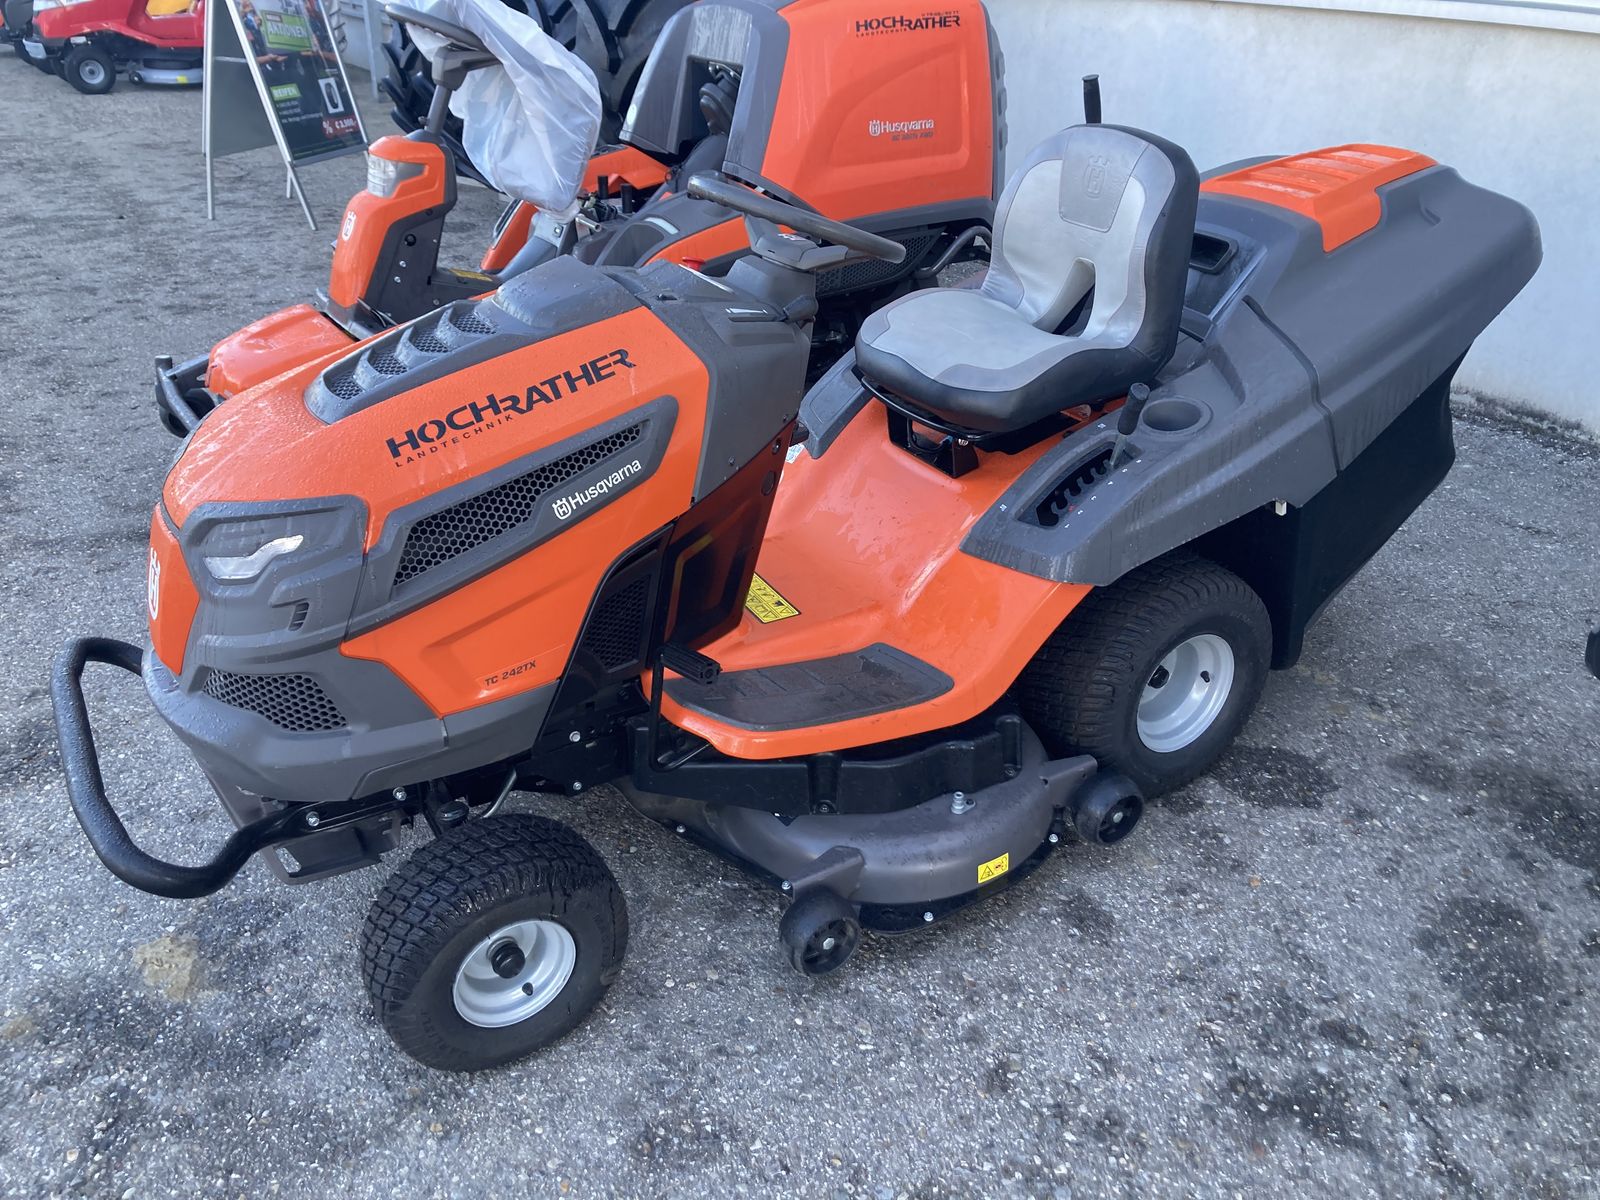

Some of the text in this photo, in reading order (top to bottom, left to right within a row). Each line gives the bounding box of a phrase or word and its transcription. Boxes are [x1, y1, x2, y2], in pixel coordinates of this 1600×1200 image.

[856, 15, 961, 32] HOCHRATHER
[881, 118, 934, 133] Husqvarna
[385, 348, 636, 458] HOCHRATHER
[395, 413, 514, 467] LANDTECHNIK
[568, 459, 642, 510] Husqvarna
[485, 660, 536, 686] TC 242TX
